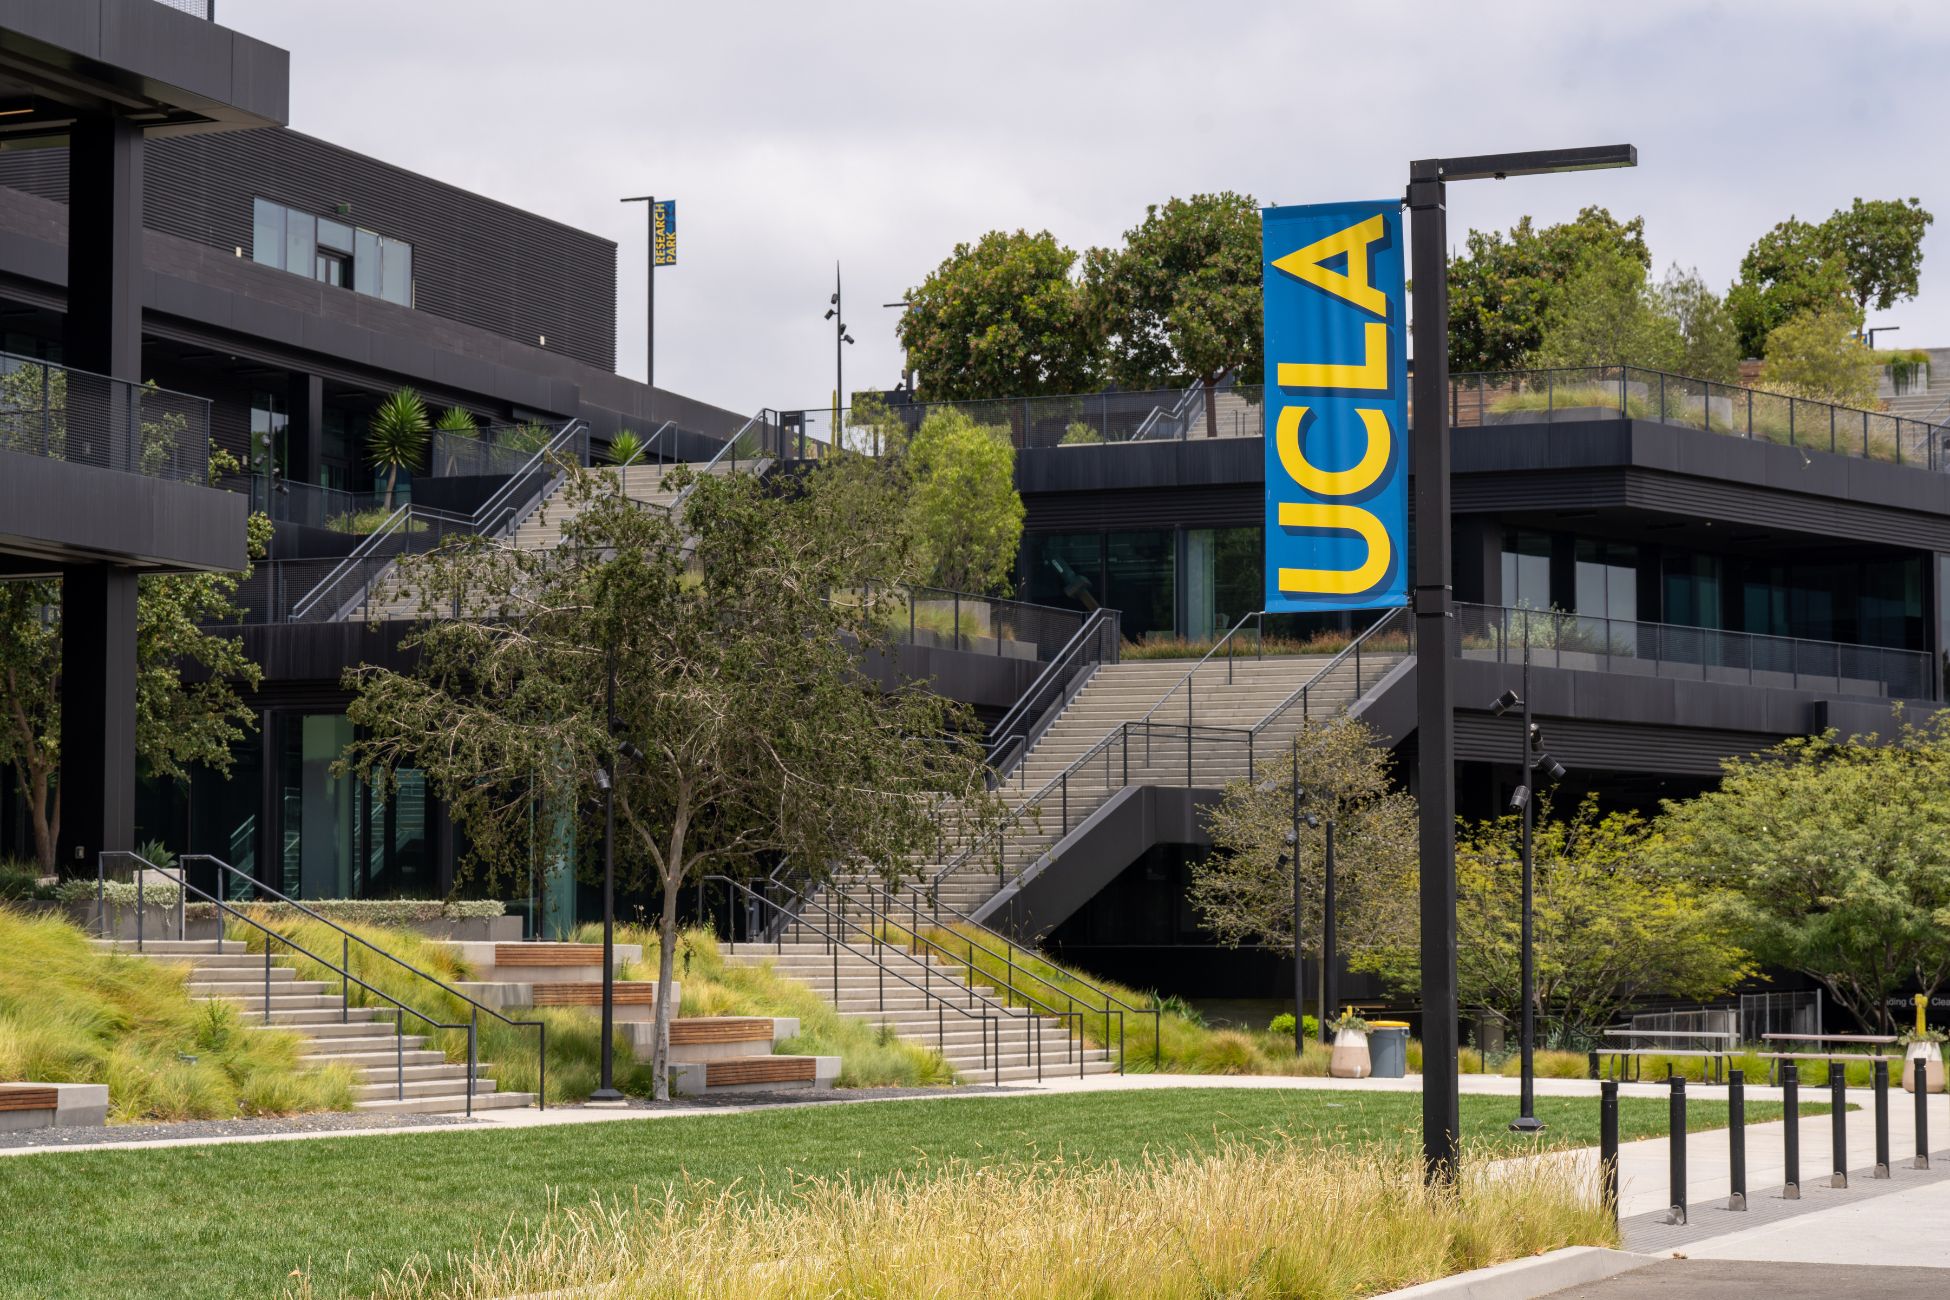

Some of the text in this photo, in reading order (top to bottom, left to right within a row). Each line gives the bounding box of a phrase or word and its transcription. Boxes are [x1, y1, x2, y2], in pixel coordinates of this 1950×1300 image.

[655, 203, 665, 264] RESEARCH
[666, 231, 676, 263] PARK
[1271, 213, 1393, 595] UCLA
